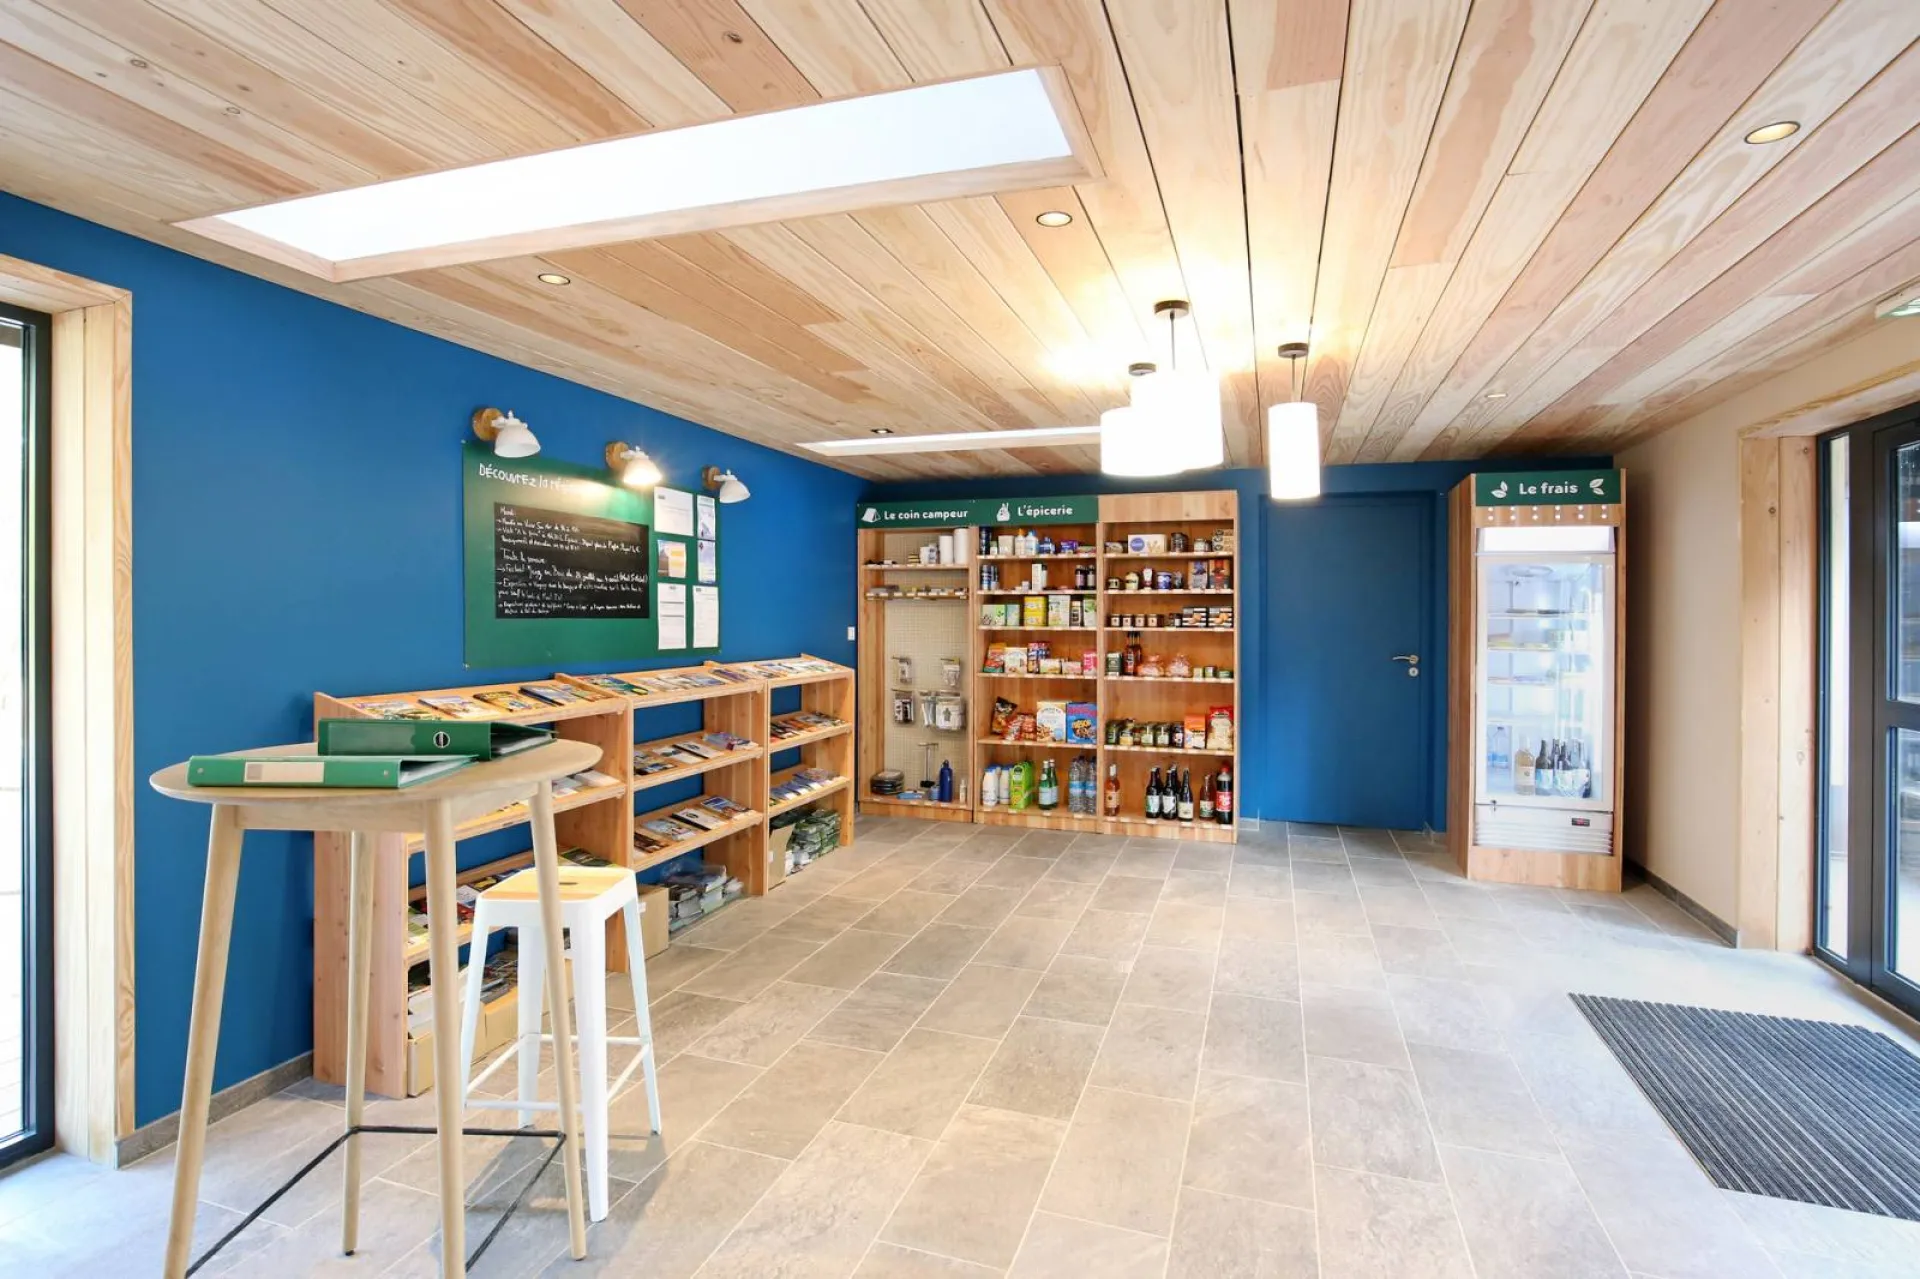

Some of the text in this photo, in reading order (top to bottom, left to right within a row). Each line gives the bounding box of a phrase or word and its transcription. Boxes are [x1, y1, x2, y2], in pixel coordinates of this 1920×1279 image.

[1519, 481, 1578, 495] Le frais
[884, 508, 968, 521] Le coin campeur
[1017, 504, 1073, 518] L'épicerie
